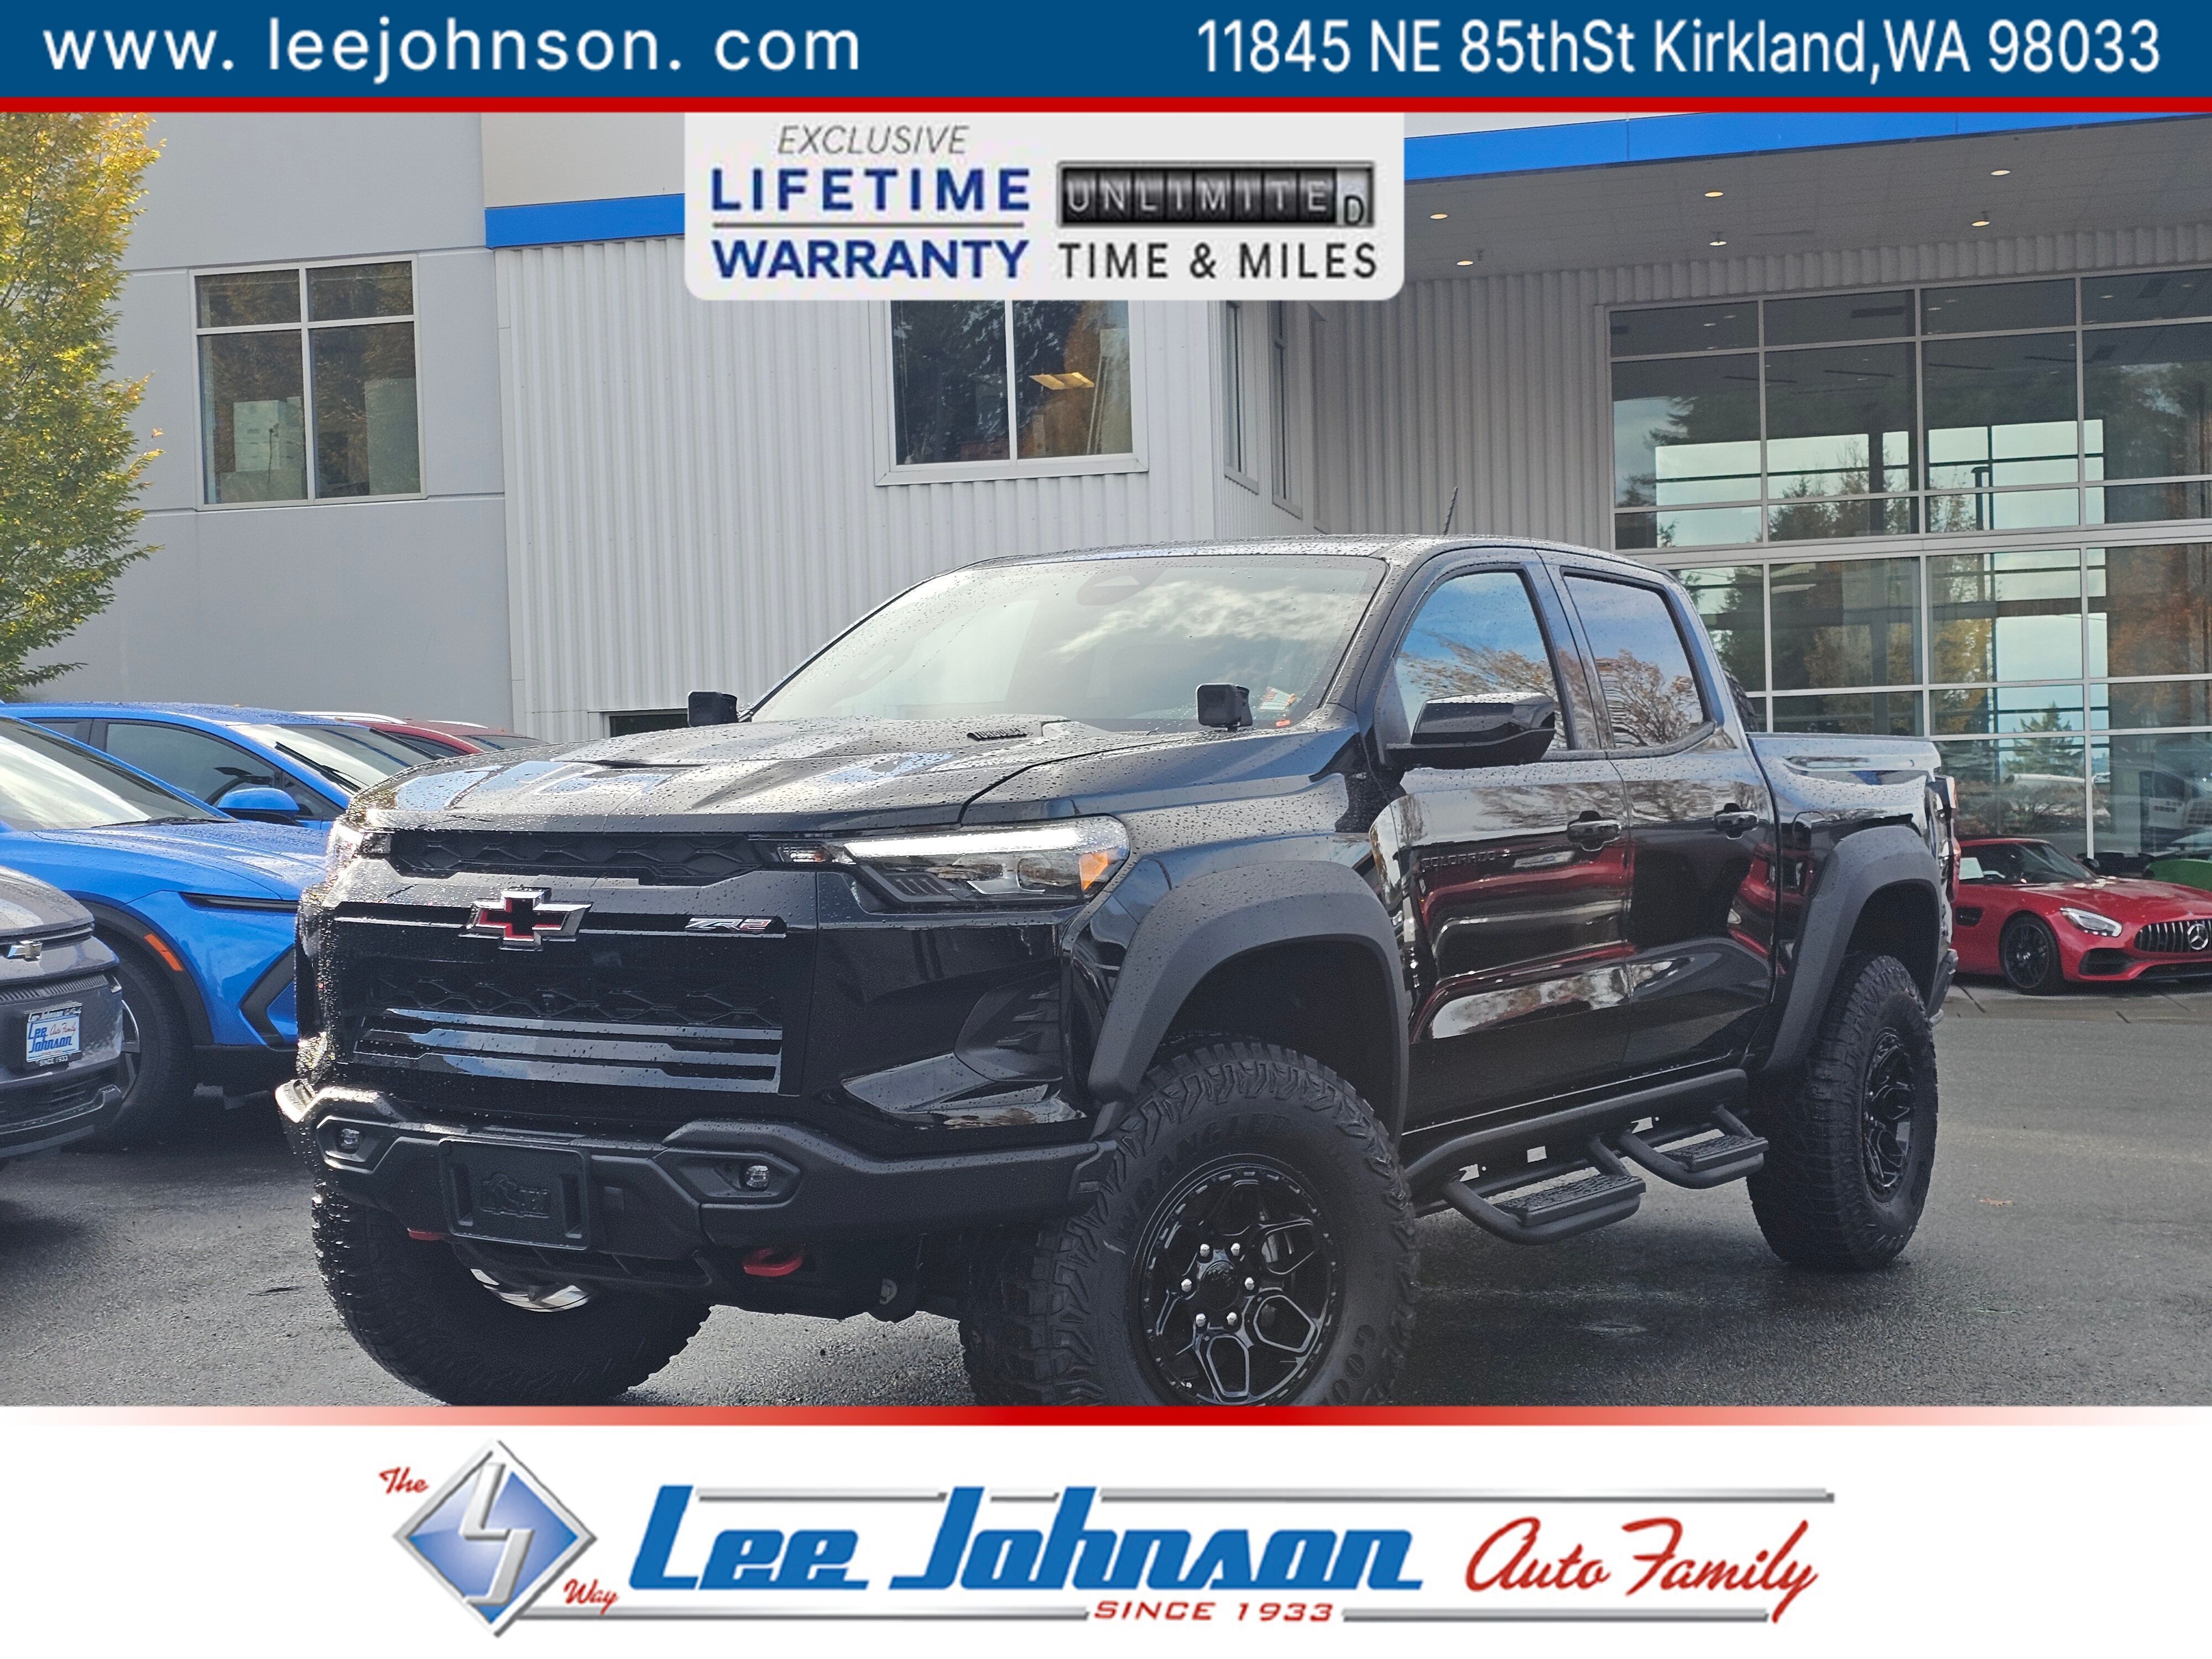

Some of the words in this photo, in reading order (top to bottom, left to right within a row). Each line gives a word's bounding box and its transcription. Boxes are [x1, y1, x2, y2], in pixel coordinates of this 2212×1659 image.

[685, 917, 772, 932] ZR2
[28, 1022, 48, 1040] Lee
[29, 1036, 72, 1053] Johnson
